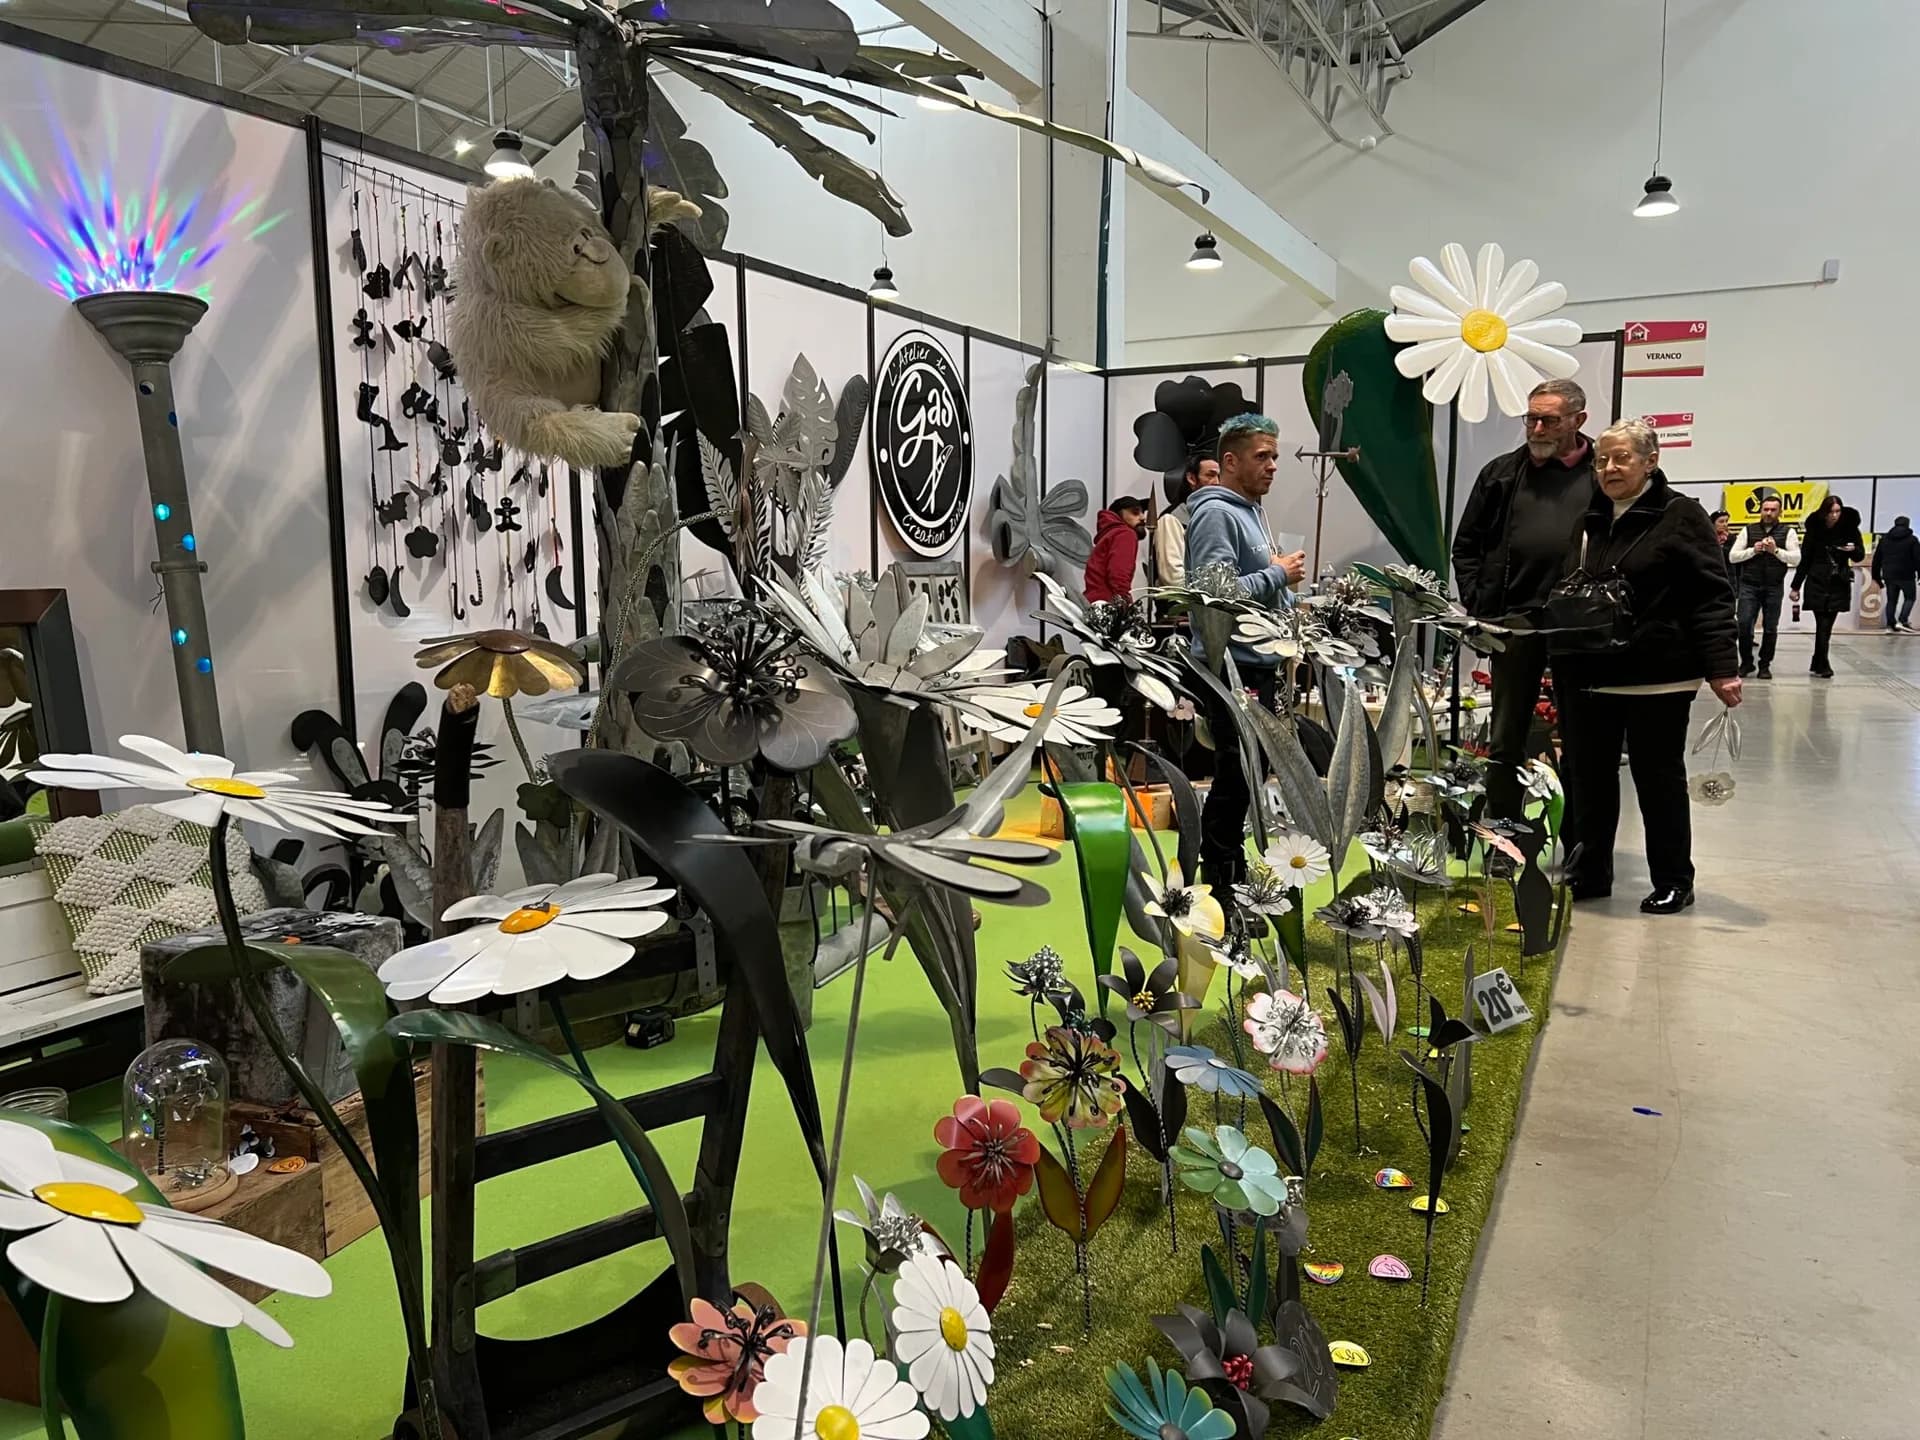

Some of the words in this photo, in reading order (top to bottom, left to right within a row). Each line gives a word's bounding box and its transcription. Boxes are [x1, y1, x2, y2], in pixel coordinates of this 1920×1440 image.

[1689, 323, 1705, 333] A9
[1646, 352, 1682, 360] VERANCO
[887, 343, 930, 388] L'Atelier
